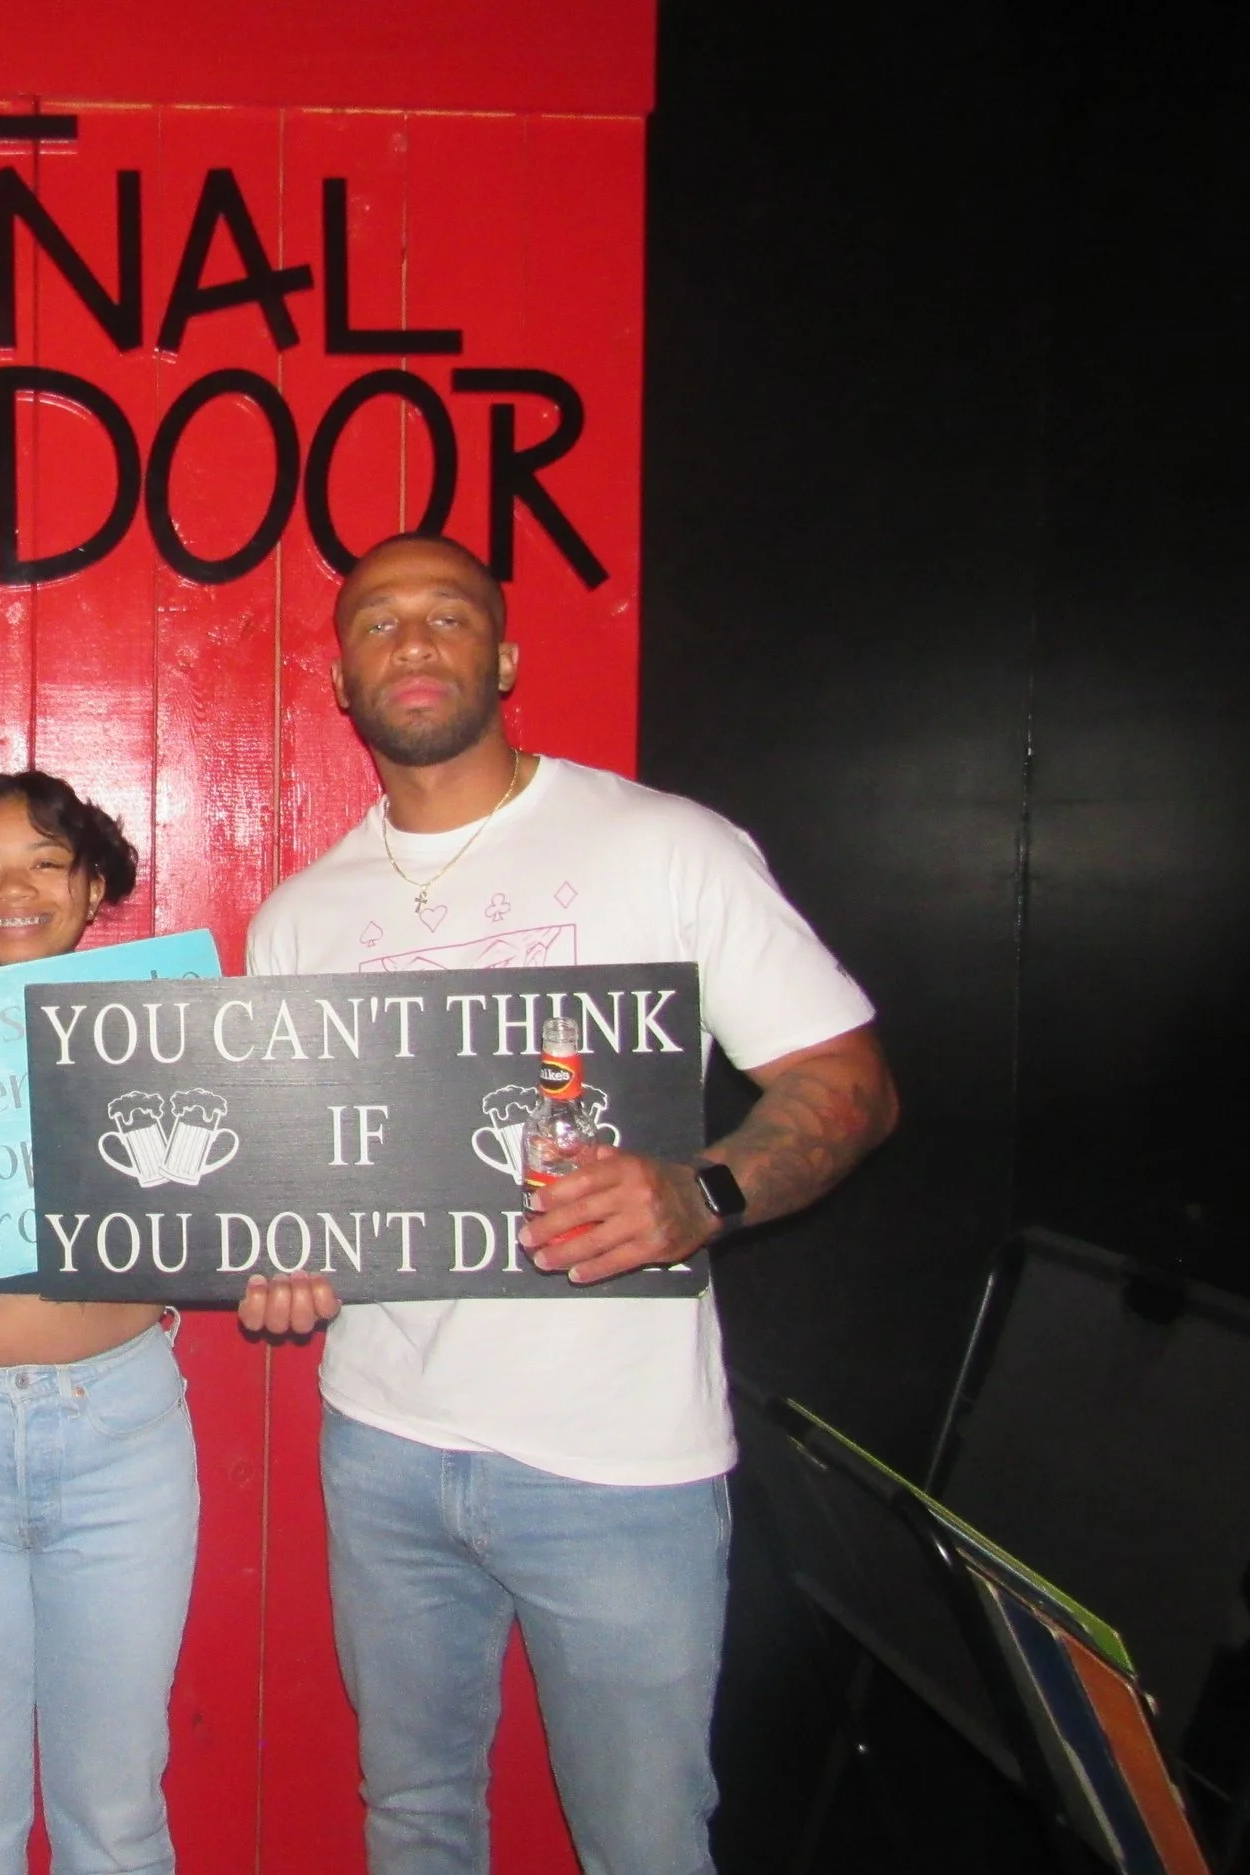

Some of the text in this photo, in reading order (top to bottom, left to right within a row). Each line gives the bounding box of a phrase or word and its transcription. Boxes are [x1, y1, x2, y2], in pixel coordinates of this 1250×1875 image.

[41, 1002, 191, 1065] YOU
[213, 996, 425, 1063] CAN'T
[327, 1104, 389, 1167] IF
[45, 1211, 192, 1274] YOU
[215, 1210, 426, 1274] DON'T
